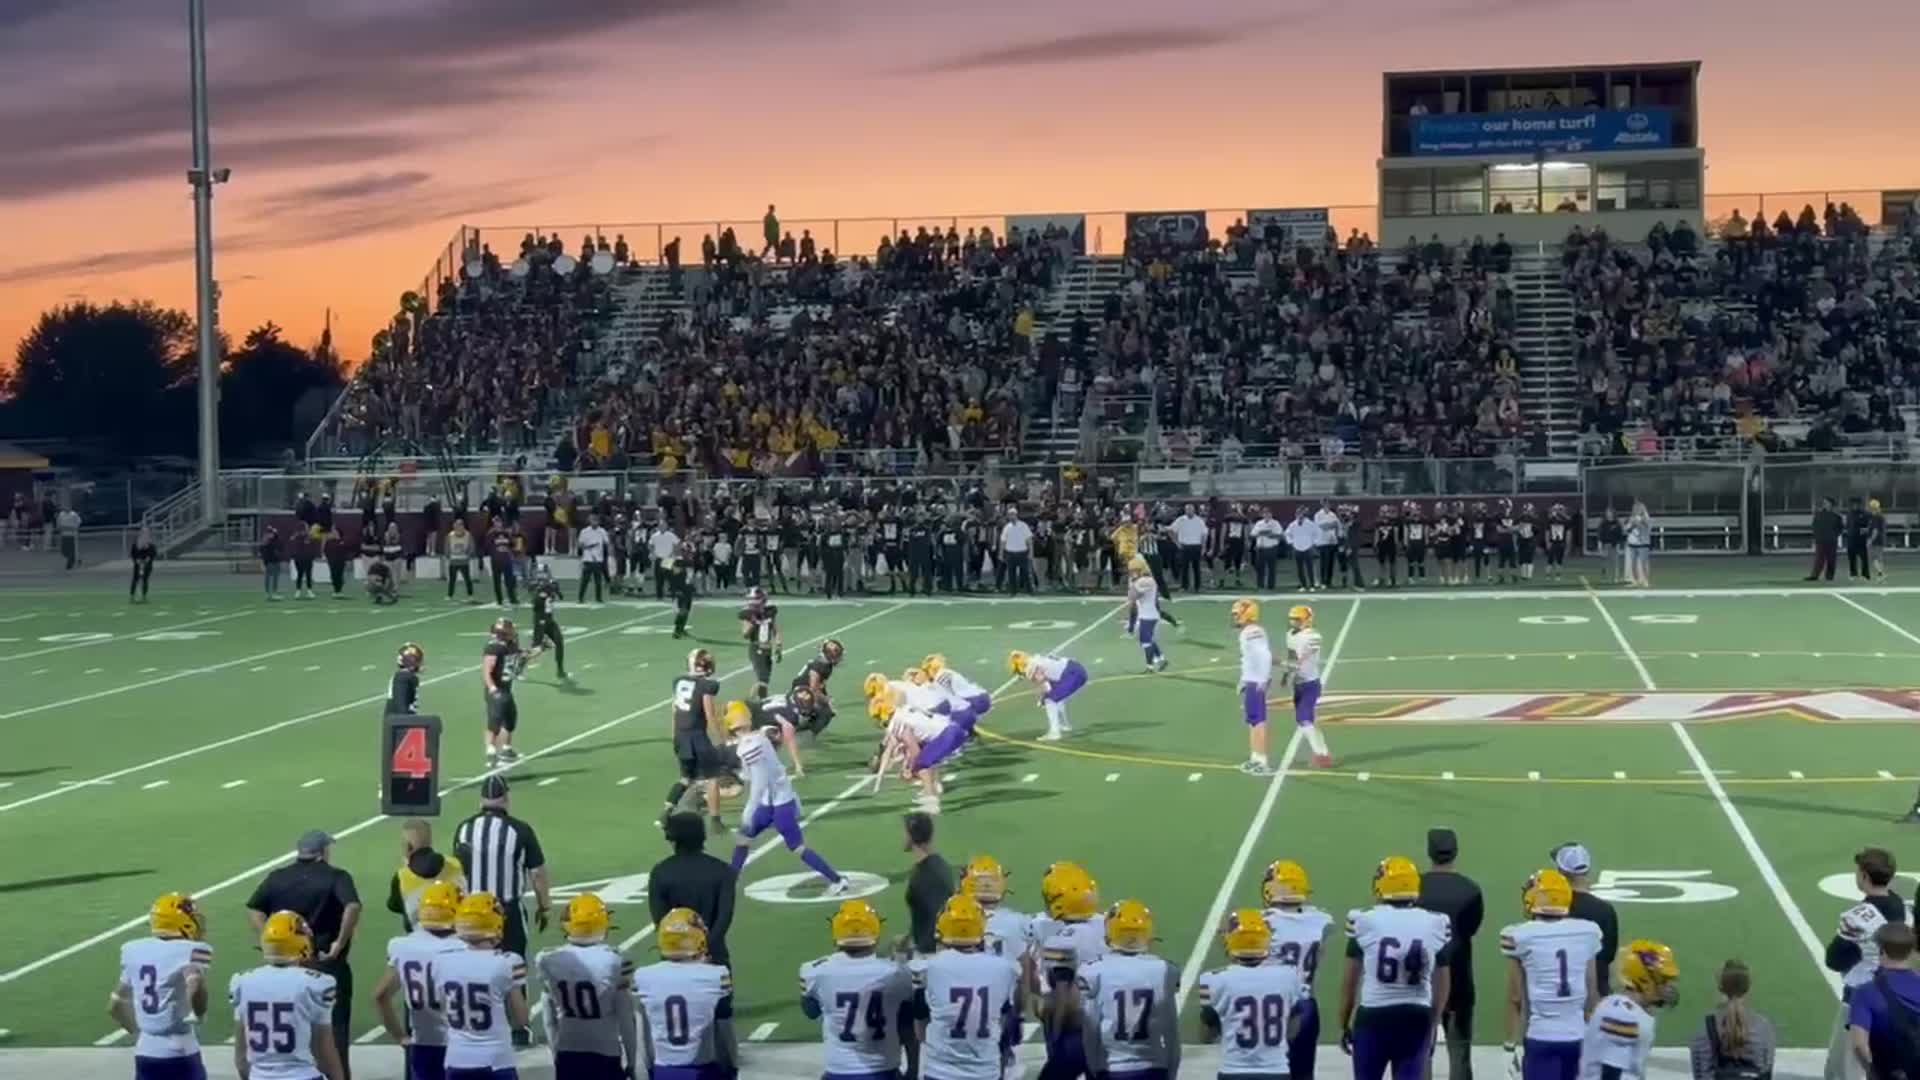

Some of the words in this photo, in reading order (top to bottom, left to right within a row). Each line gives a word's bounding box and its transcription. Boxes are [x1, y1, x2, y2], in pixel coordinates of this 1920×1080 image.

[1481, 119, 1509, 132] our
[1511, 117, 1556, 131] home
[1558, 113, 1597, 130] turf!
[391, 727, 433, 778] 4
[1376, 936, 1428, 986] 64
[1555, 949, 1572, 998] 1
[138, 964, 160, 1015] 3
[444, 981, 493, 1031] 35
[556, 979, 602, 1020] 10
[949, 985, 991, 1040] 71
[1112, 988, 1155, 1041] 17
[247, 1001, 297, 1054] 55
[664, 994, 690, 1046] 0
[835, 990, 887, 1042] 74
[1234, 993, 1285, 1049] 38
